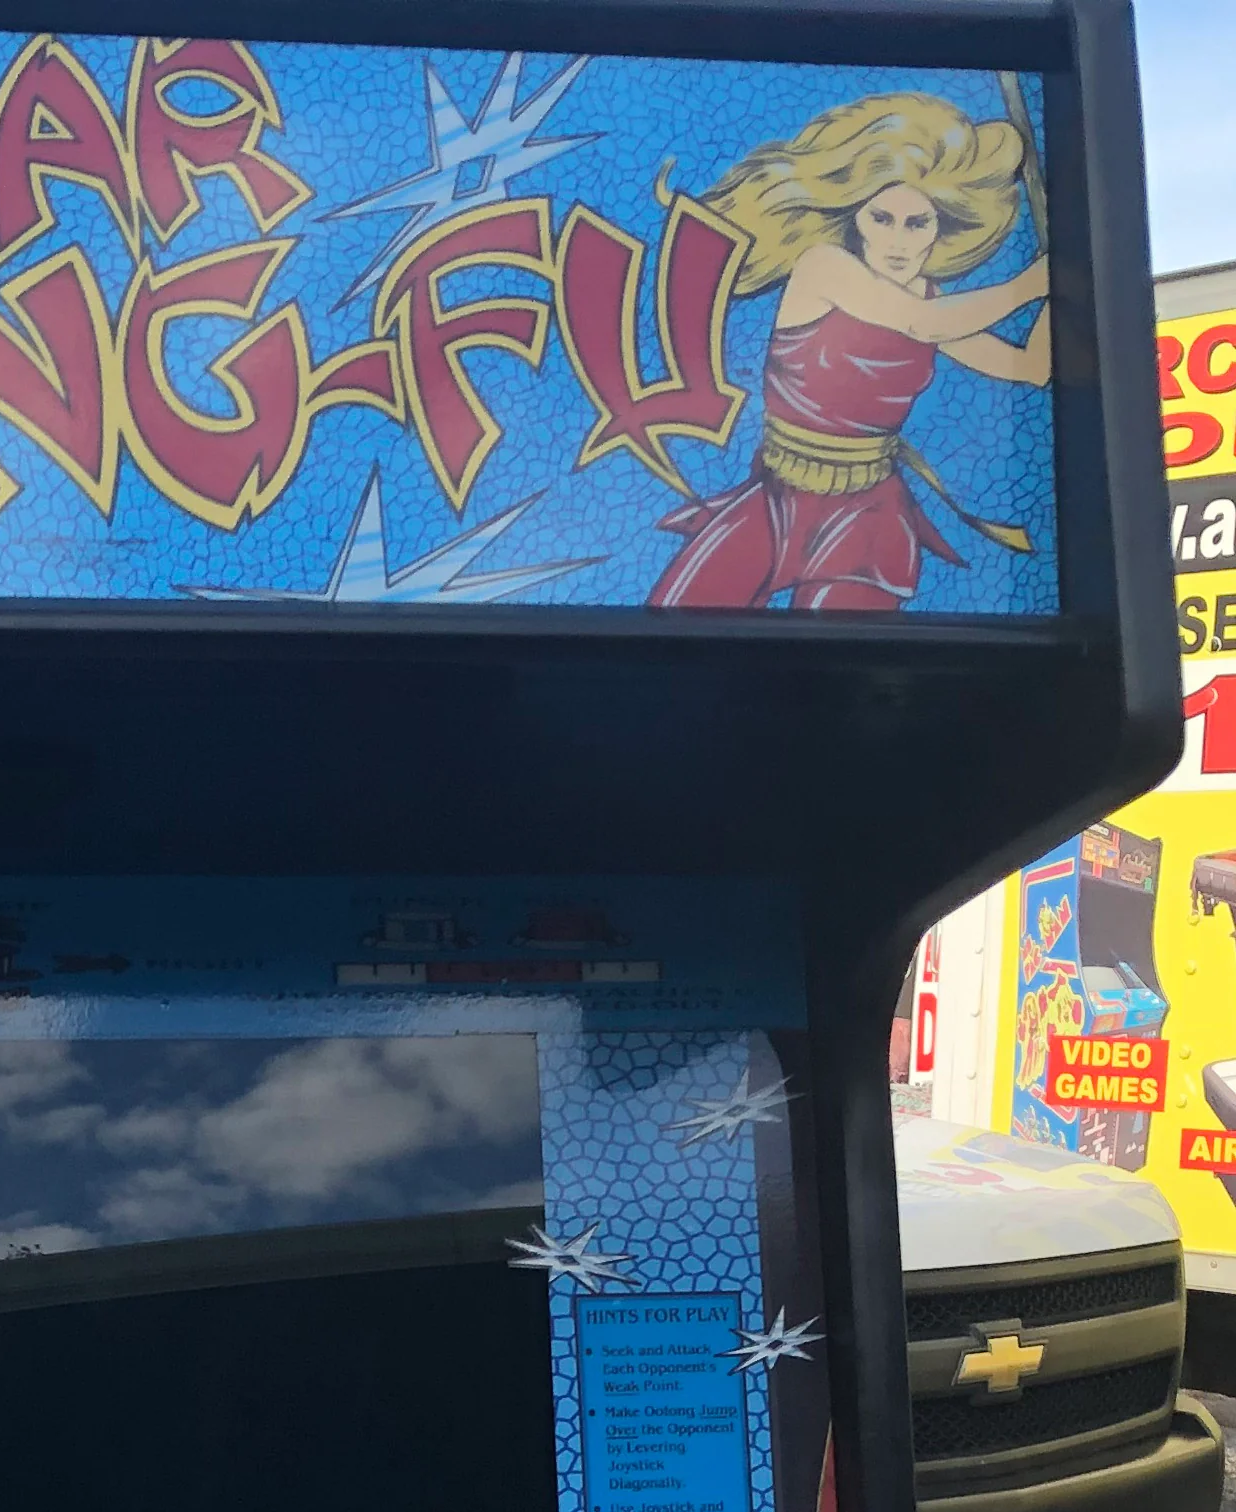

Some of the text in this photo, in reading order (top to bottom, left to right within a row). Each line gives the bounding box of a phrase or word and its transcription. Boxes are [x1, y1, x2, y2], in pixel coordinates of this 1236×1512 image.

[1061, 1040, 1152, 1068] VIDEO
[1055, 1074, 1158, 1104] GAMES
[586, 1307, 729, 1324] HINTS FOR PLAY
[601, 1344, 711, 1357] Seek and Attack
[603, 1363, 634, 1374] Each
[604, 1382, 640, 1393] Weak
[606, 1404, 737, 1419] Make Oolong Jump
[606, 1422, 735, 1436] Over the Opponent
[607, 1441, 685, 1455] by Levering
[608, 1459, 665, 1473] Joystick
[699, 1502, 724, 1512] and
